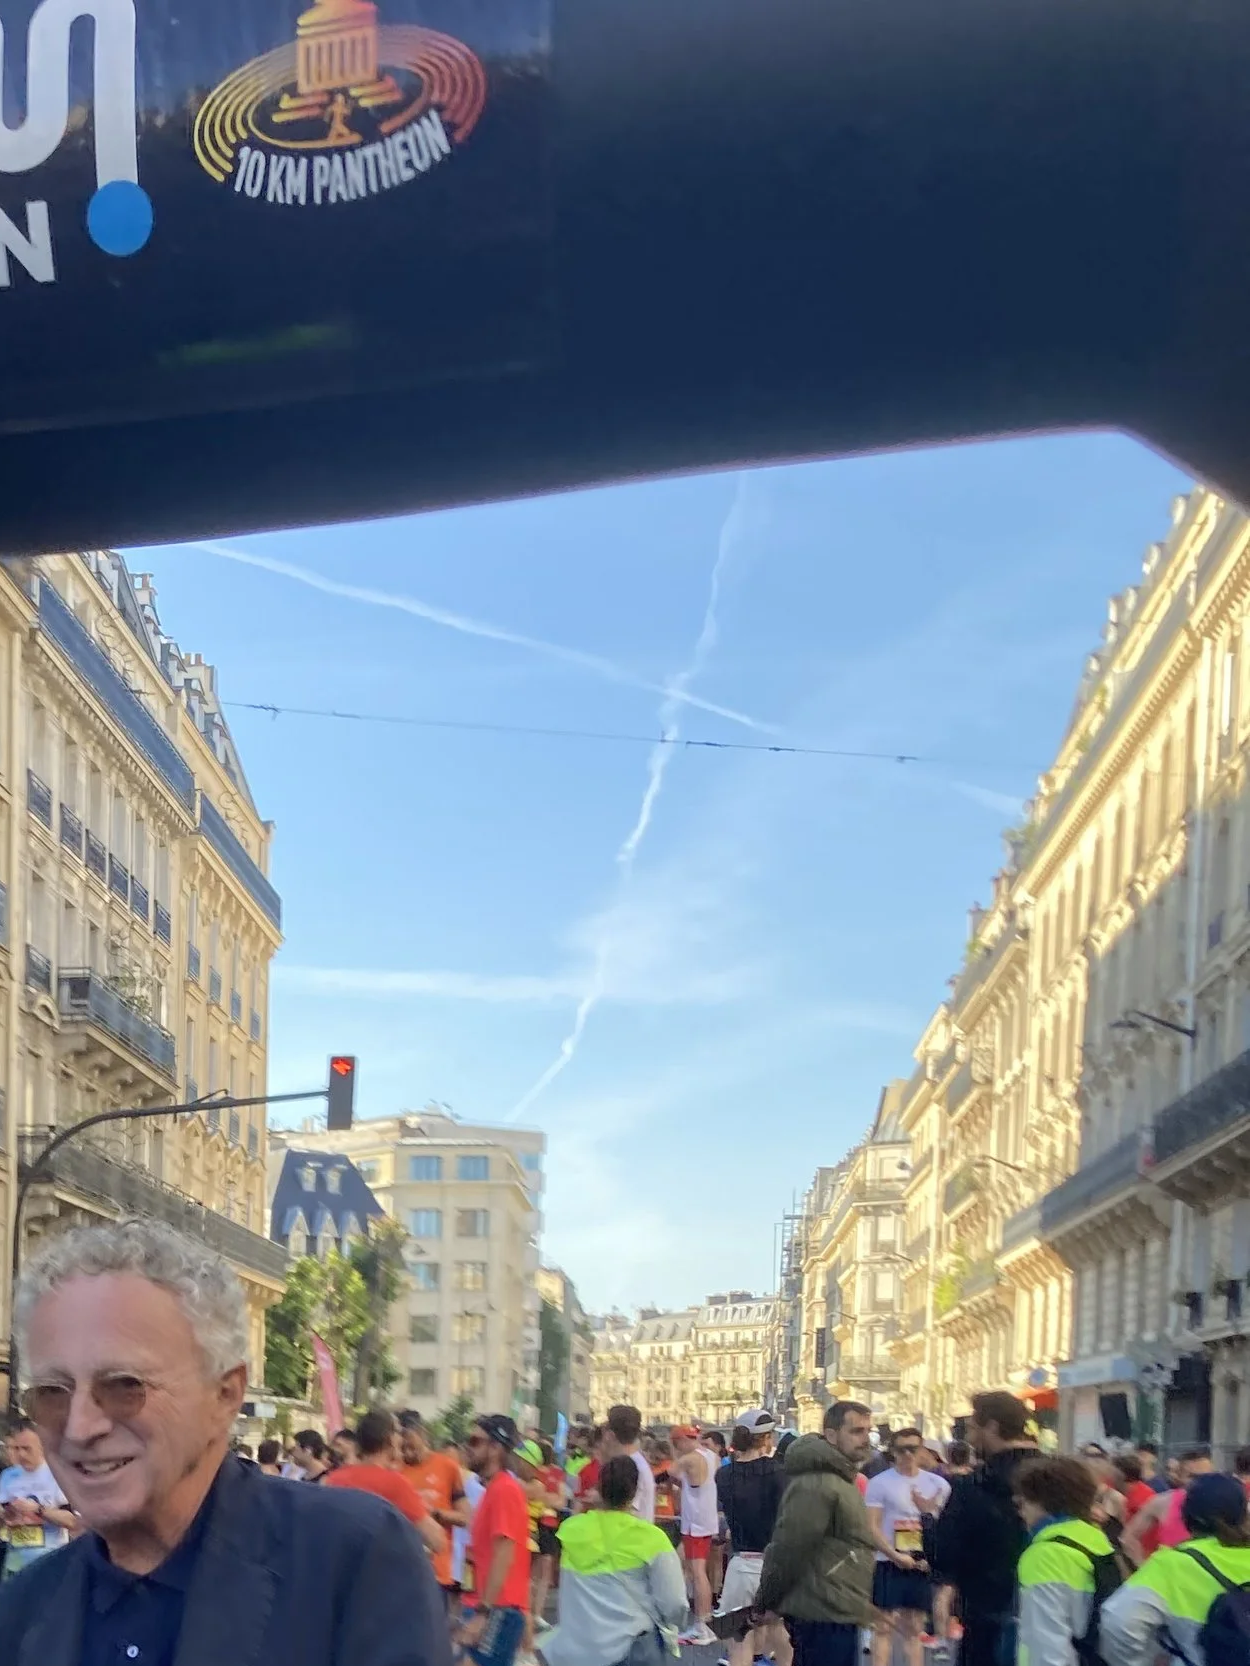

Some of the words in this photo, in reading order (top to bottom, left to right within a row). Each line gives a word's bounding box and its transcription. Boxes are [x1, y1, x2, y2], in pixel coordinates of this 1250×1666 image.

[234, 145, 267, 199] 10
[267, 153, 308, 206] KM
[313, 107, 452, 206] PANTHEON
